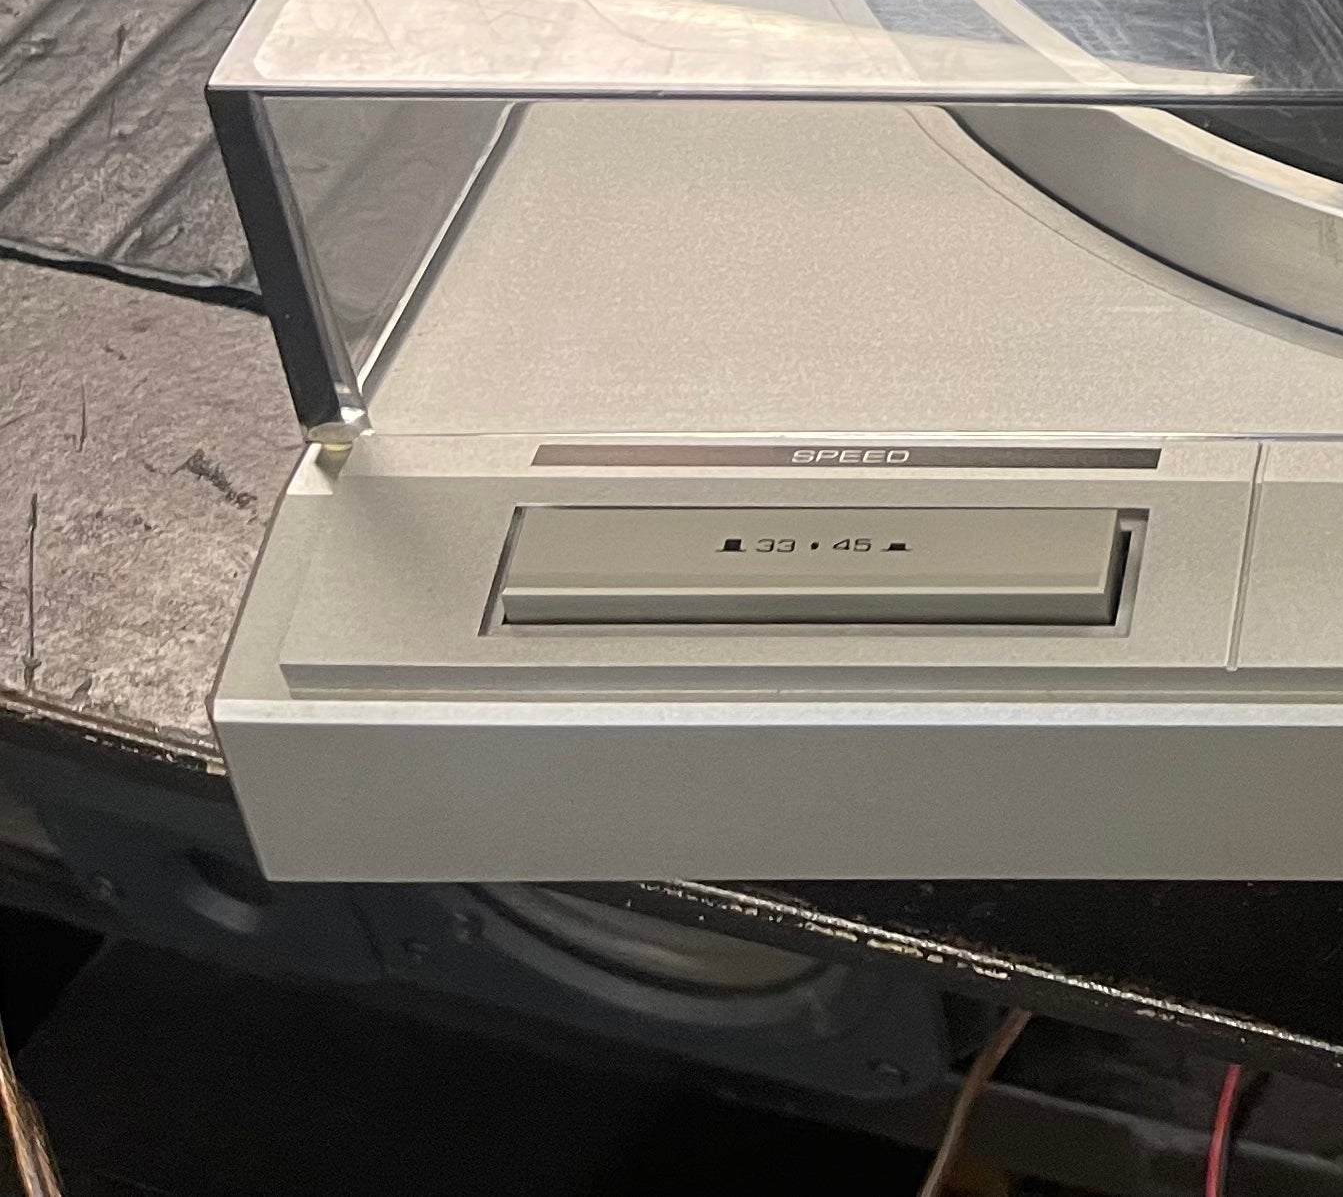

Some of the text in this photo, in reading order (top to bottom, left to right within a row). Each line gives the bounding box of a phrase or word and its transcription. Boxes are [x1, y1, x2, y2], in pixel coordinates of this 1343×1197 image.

[791, 449, 910, 464] SPEED
[755, 538, 872, 553] 33 45
